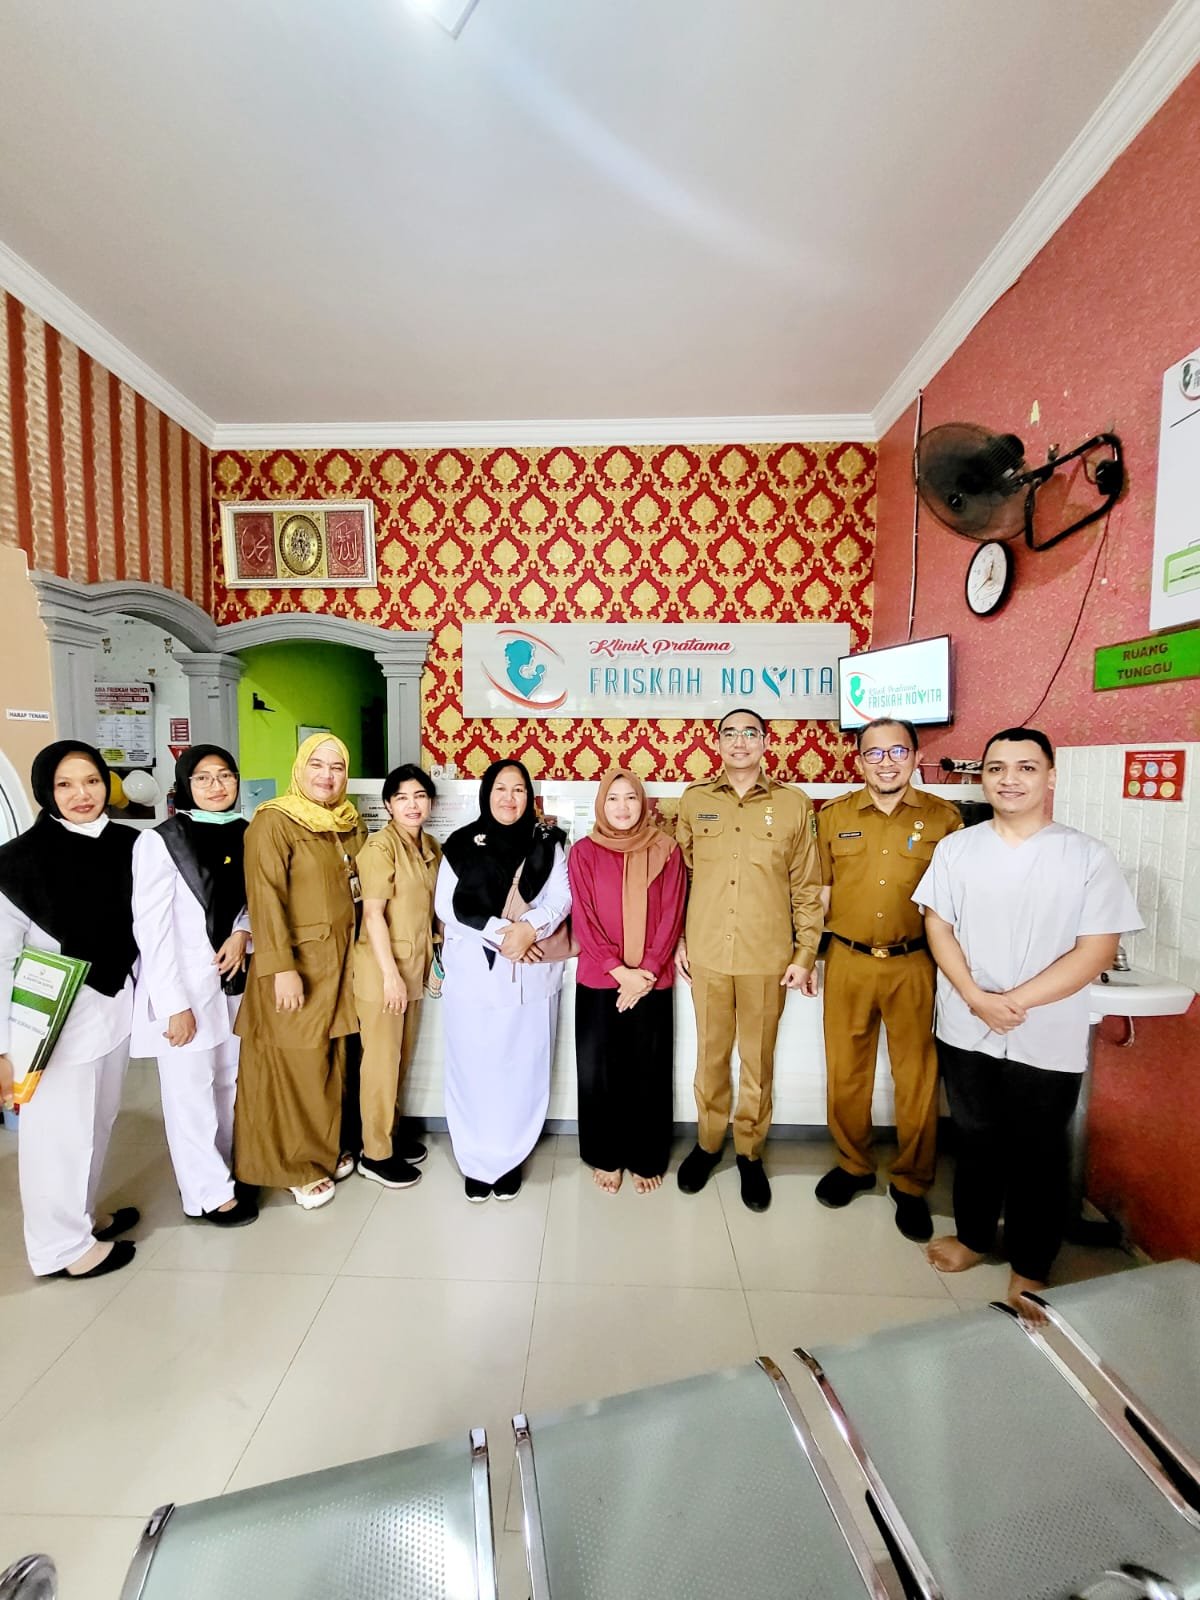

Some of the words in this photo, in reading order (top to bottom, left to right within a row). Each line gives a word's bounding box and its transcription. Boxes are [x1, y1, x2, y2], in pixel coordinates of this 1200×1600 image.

[589, 638, 649, 657] Klinik
[652, 638, 731, 655] Pratama
[1123, 643, 1168, 661] RUANG
[1117, 662, 1172, 680] TUNGGU
[590, 666, 702, 696] FRISKAH
[721, 665, 834, 698] NOVITA
[868, 694, 902, 709] FRISKAH
[905, 688, 942, 705] NOVITA
